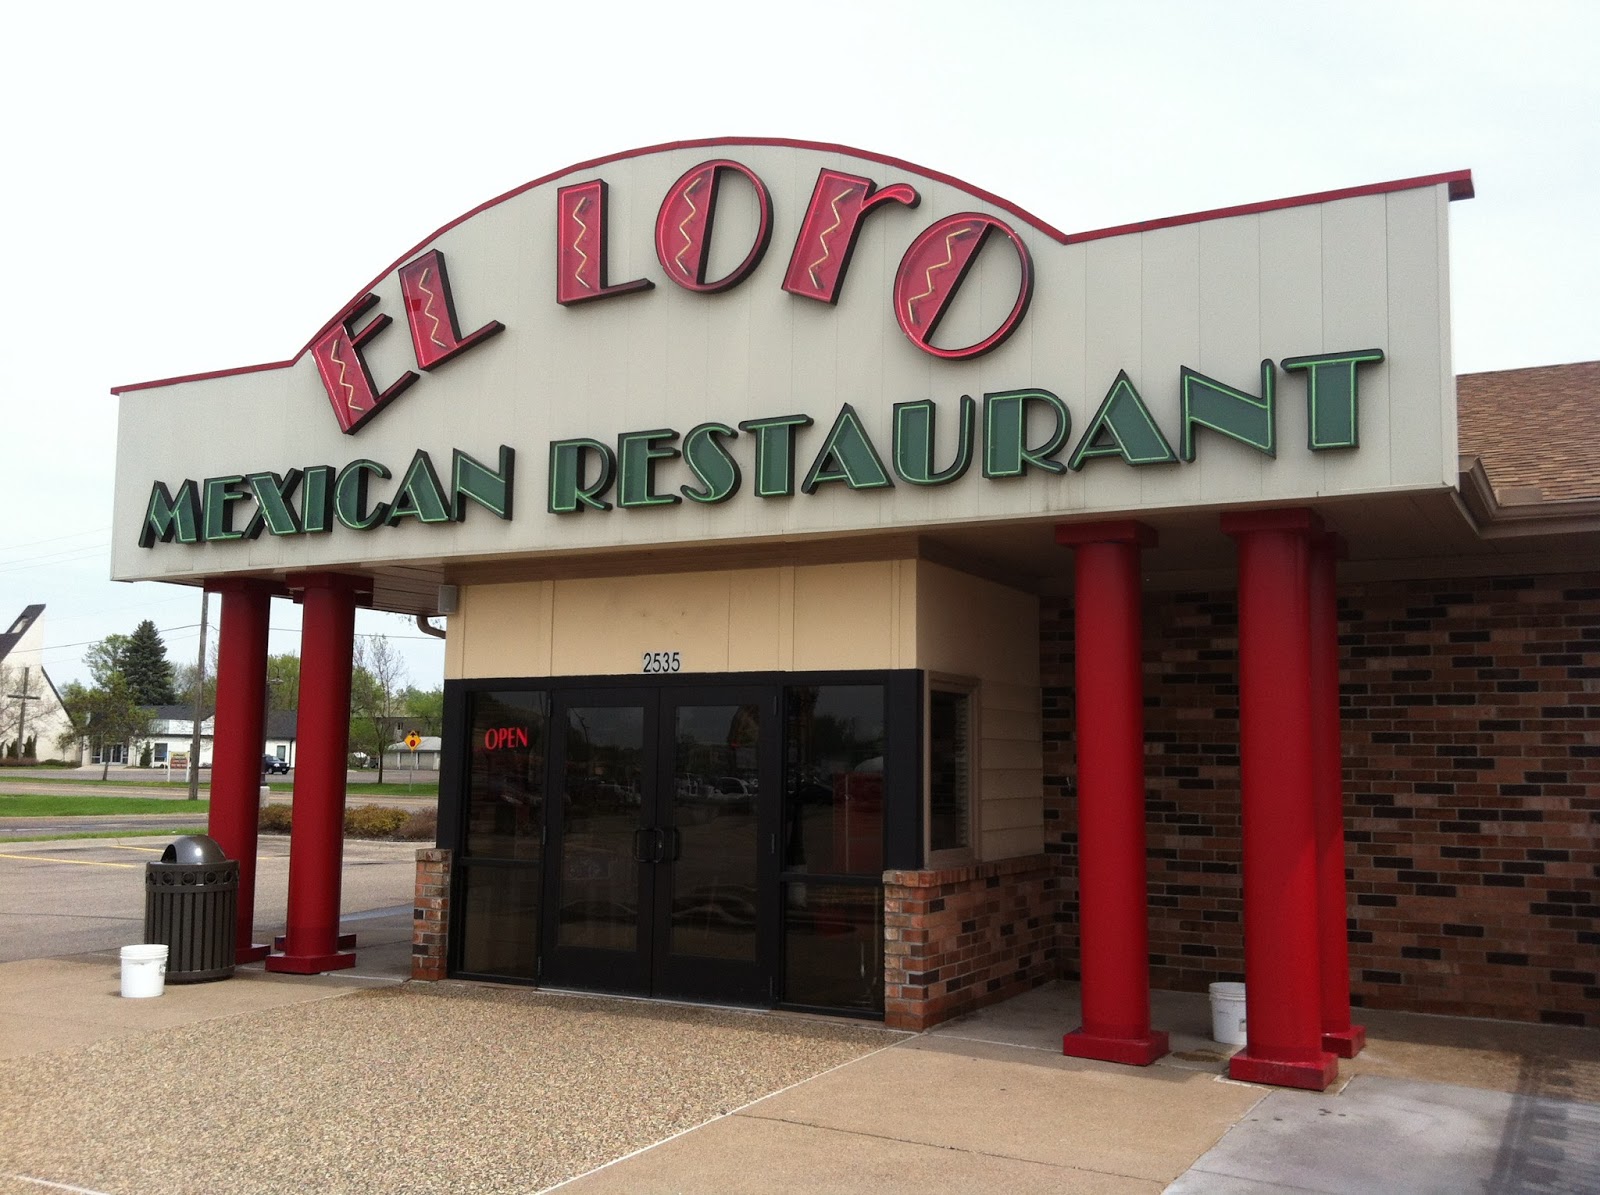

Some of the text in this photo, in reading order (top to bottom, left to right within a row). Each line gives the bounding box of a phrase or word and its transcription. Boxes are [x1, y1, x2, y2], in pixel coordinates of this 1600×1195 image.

[311, 249, 505, 434] EL
[138, 349, 1385, 547] MEXICAN RESTAURANT
[643, 652, 681, 673] 2535
[484, 727, 529, 749] OPEN
